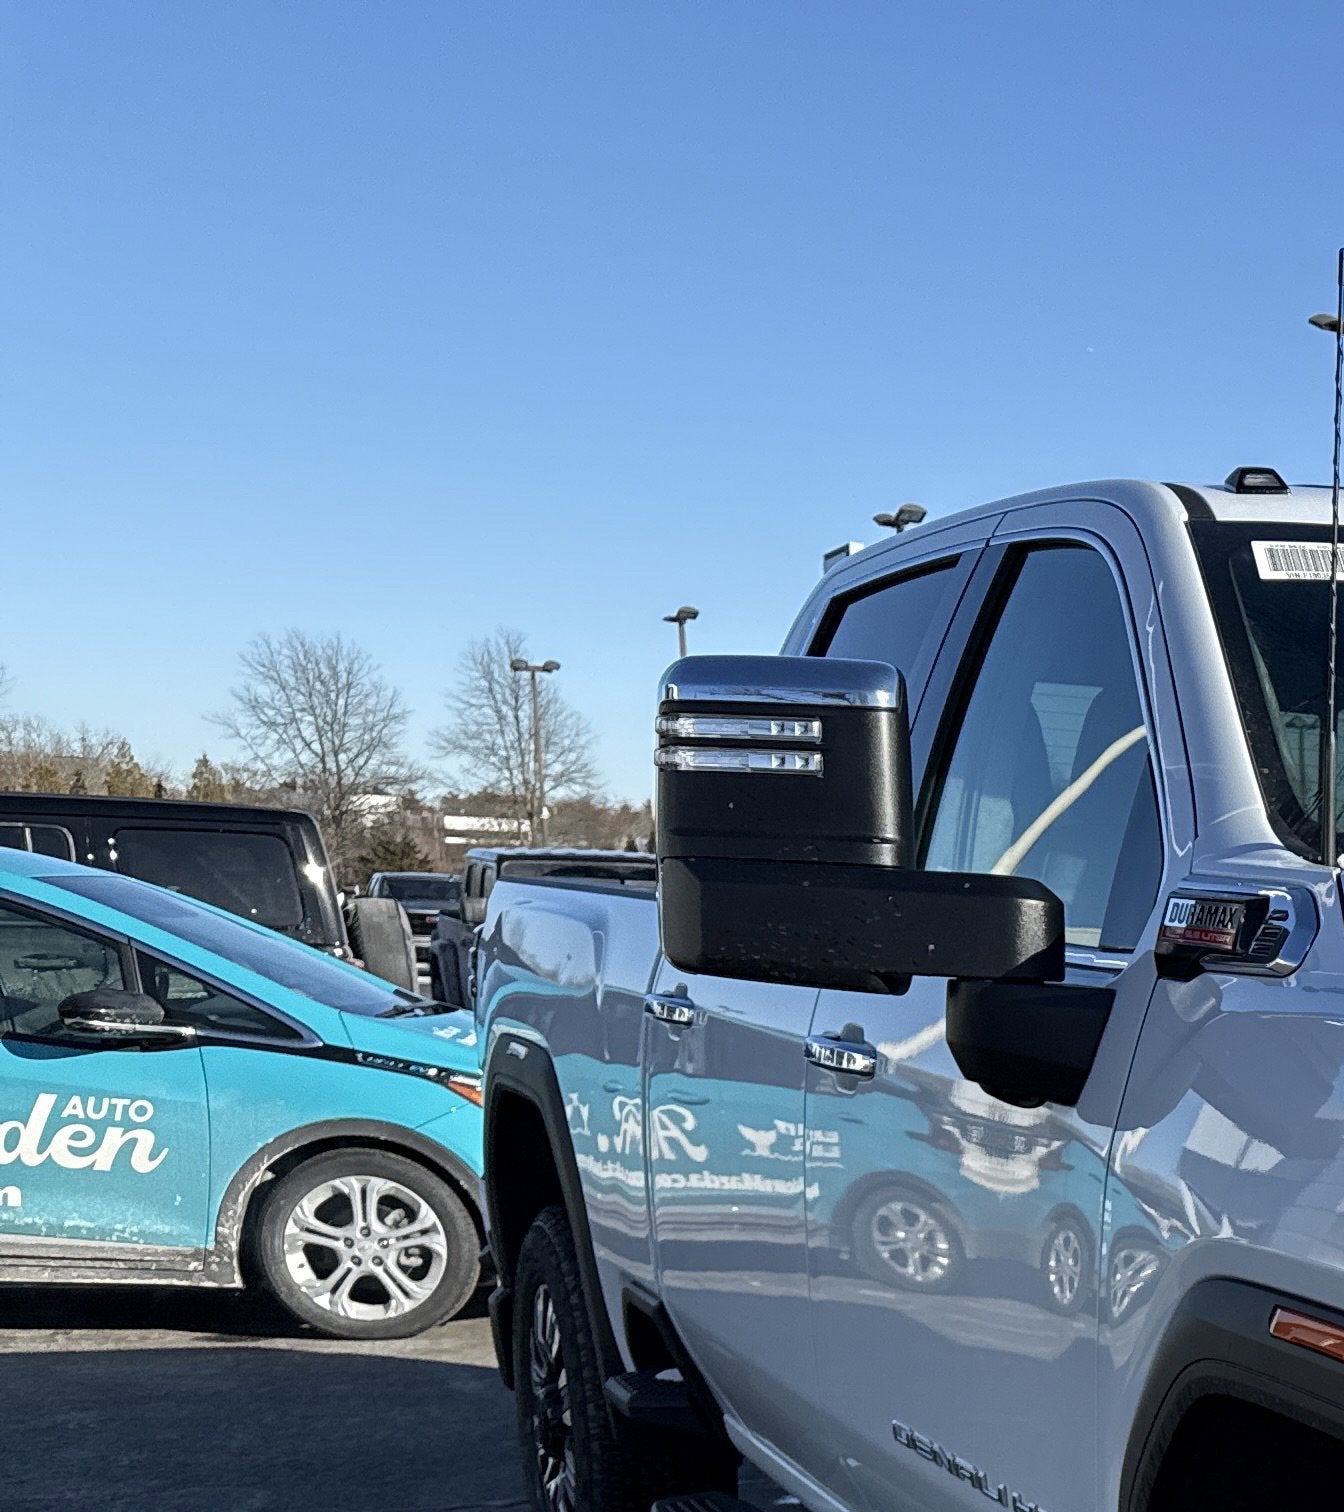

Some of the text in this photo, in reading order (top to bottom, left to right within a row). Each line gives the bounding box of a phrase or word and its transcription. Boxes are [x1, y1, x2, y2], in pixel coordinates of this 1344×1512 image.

[1168, 902, 1239, 928] DURAMAX
[60, 1095, 154, 1123] AUTO
[892, 1419, 1009, 1508] DENALI
